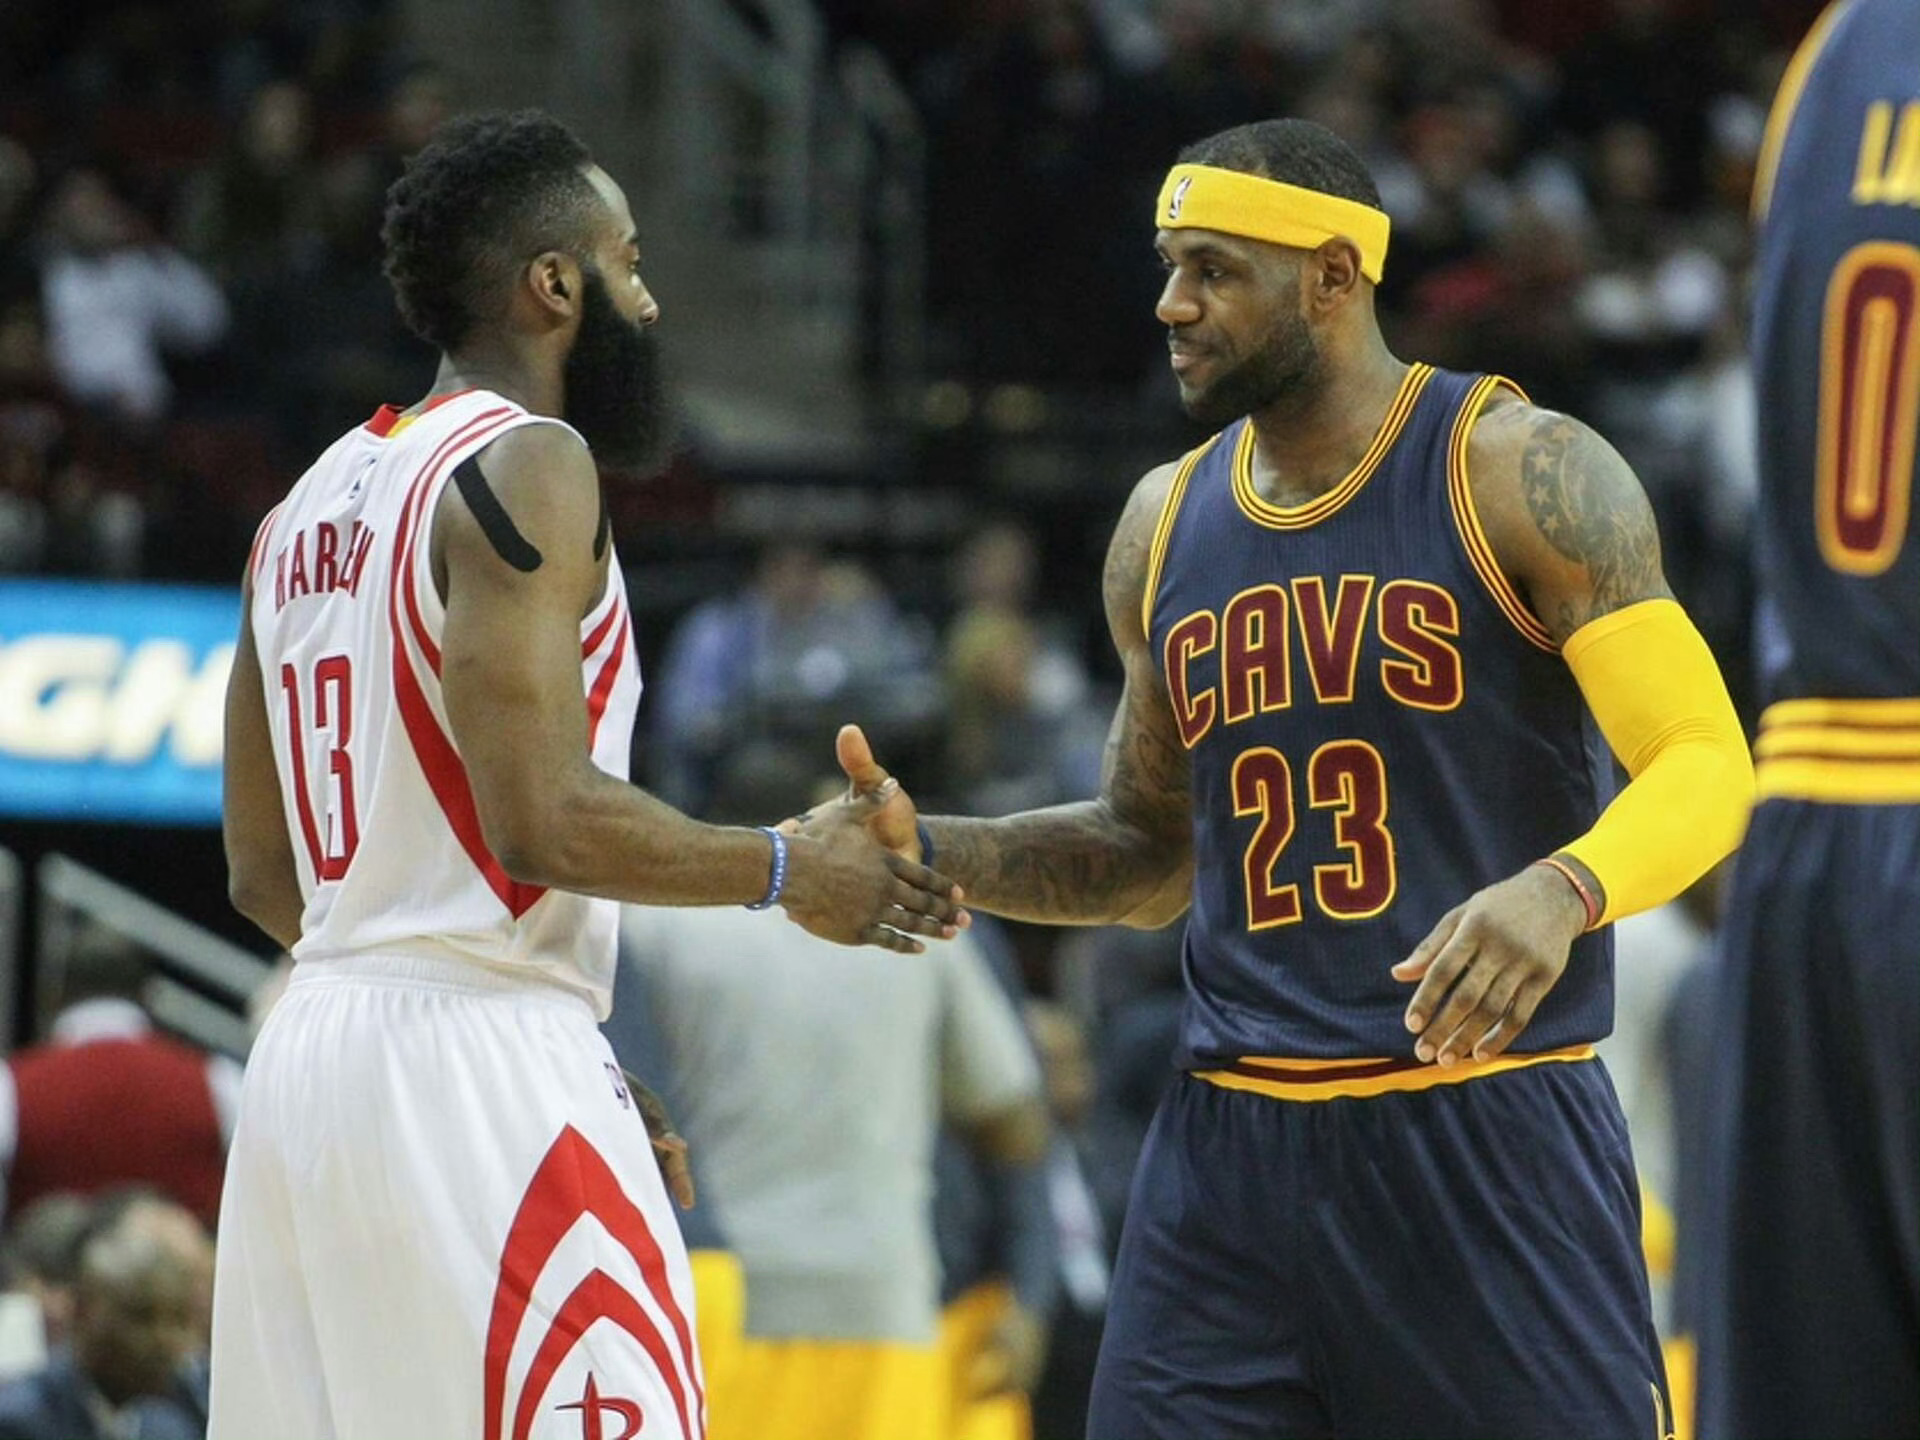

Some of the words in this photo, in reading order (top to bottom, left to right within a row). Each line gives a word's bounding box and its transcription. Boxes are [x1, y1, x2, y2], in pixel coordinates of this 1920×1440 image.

[1814, 240, 1920, 577] 0
[275, 520, 375, 614] HAREN
[1164, 574, 1464, 748] CAVS
[281, 654, 359, 885] 13
[1231, 739, 1397, 931] 23
